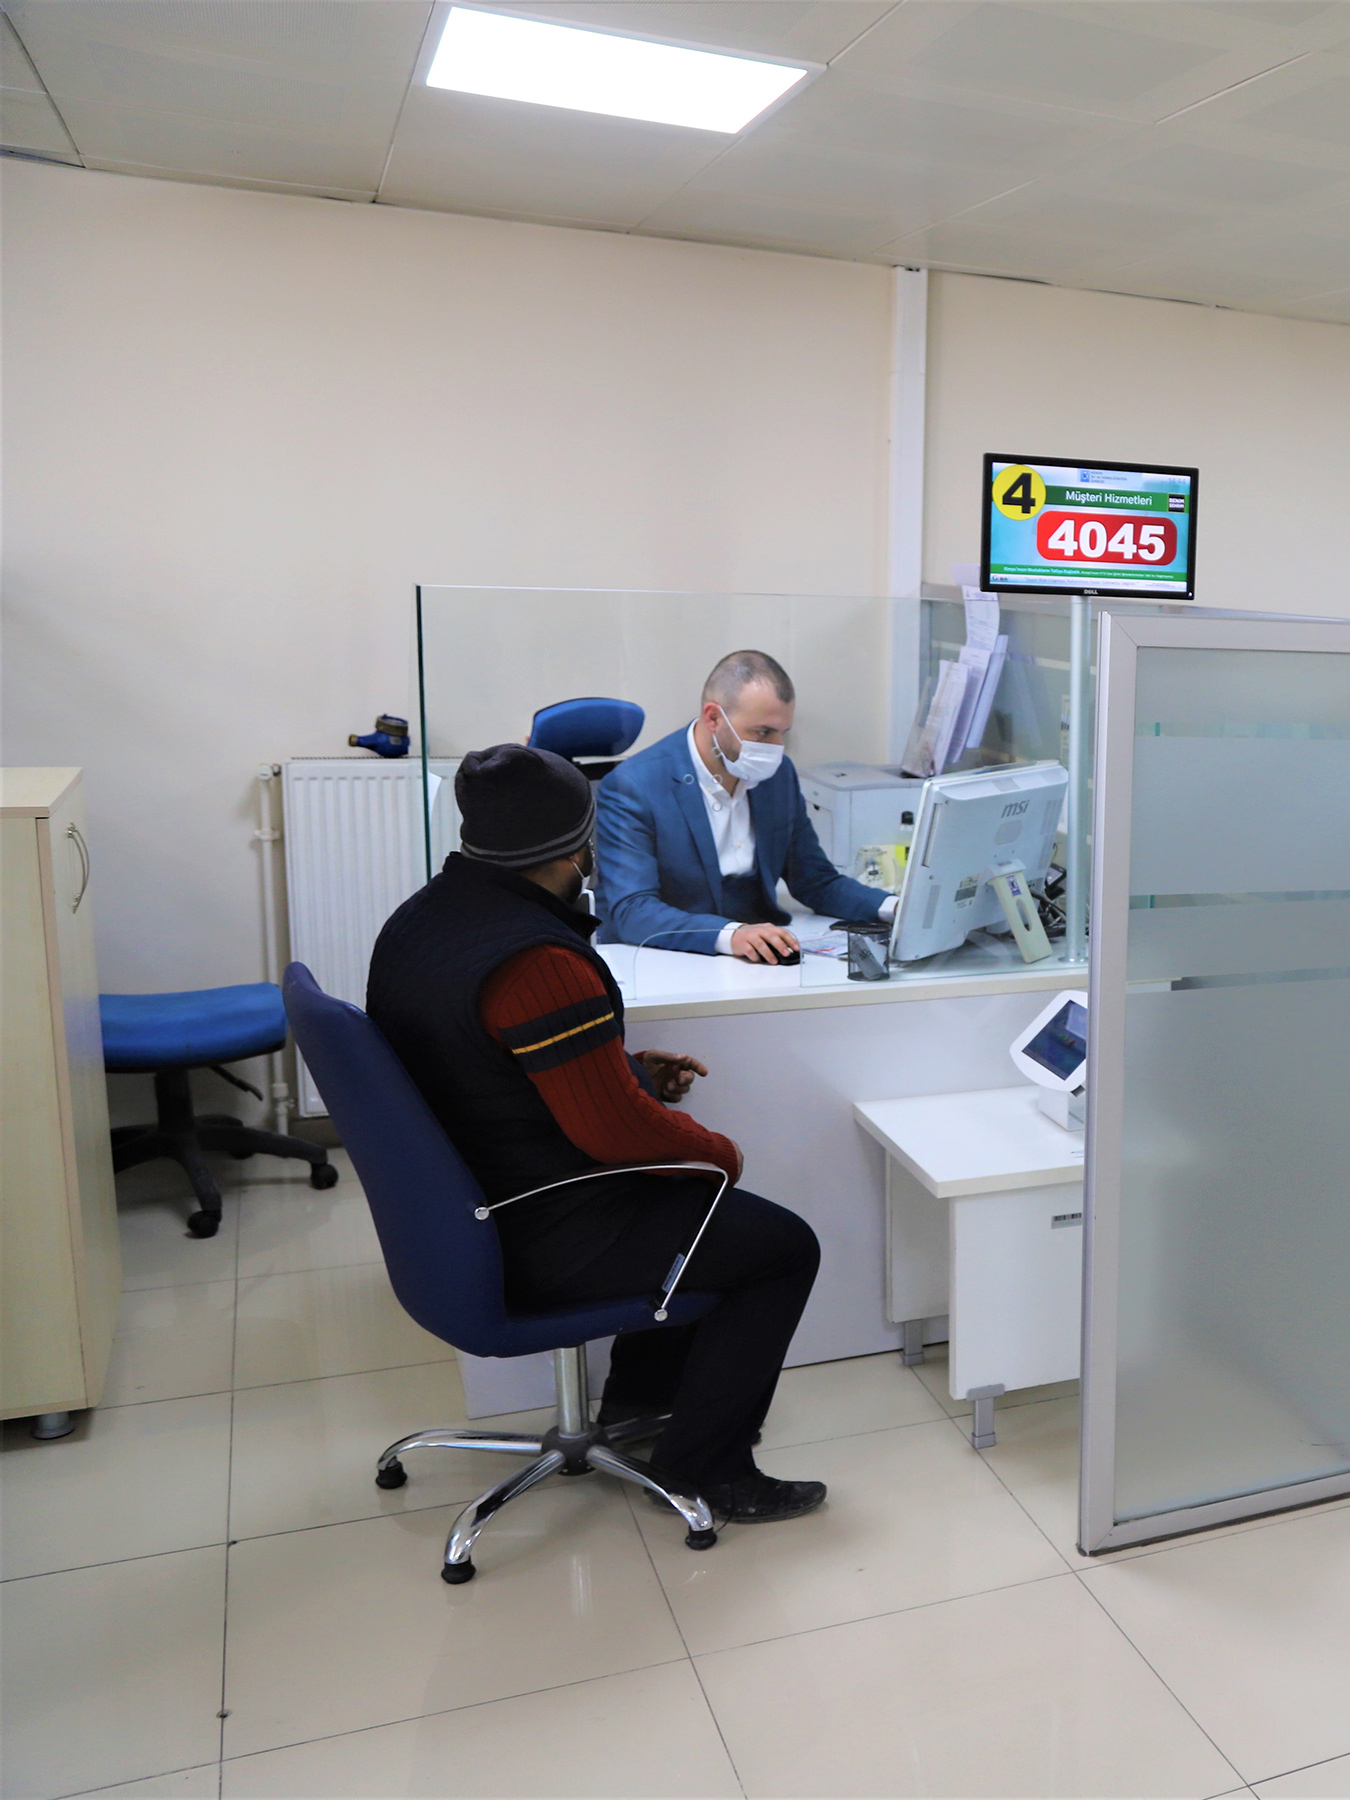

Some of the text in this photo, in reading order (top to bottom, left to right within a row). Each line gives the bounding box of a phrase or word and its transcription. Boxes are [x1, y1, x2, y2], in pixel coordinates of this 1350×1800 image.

[1002, 472, 1036, 514] 4
[1065, 490, 1153, 505] Müşteri Hizmetleri
[1047, 519, 1166, 561] 4045
[1000, 799, 1030, 818] msi
